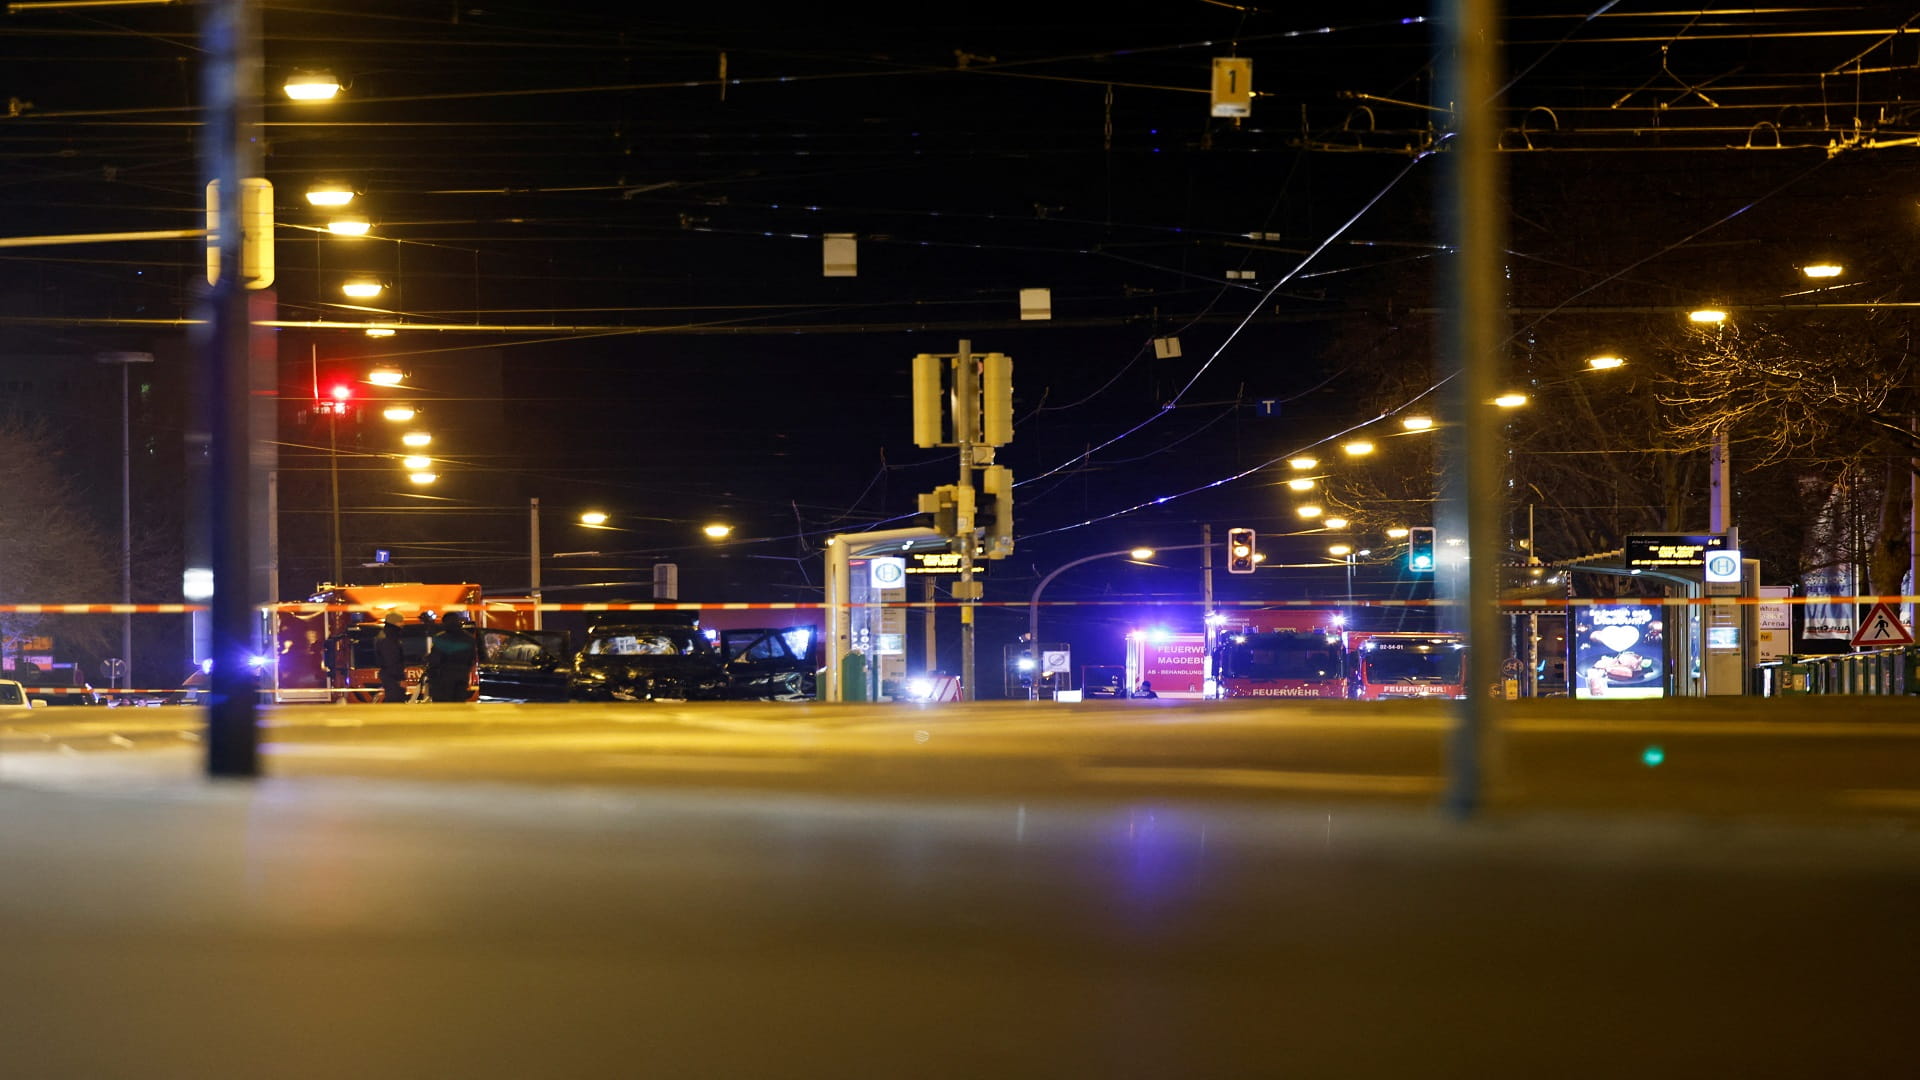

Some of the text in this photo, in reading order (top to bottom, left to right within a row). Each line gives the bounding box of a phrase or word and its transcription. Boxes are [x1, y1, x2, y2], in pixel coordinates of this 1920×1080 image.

[1228, 69, 1237, 95] 1
[1262, 400, 1275, 414] T
[379, 551, 387, 561] T
[1252, 688, 1320, 697] FEUERWEHR
